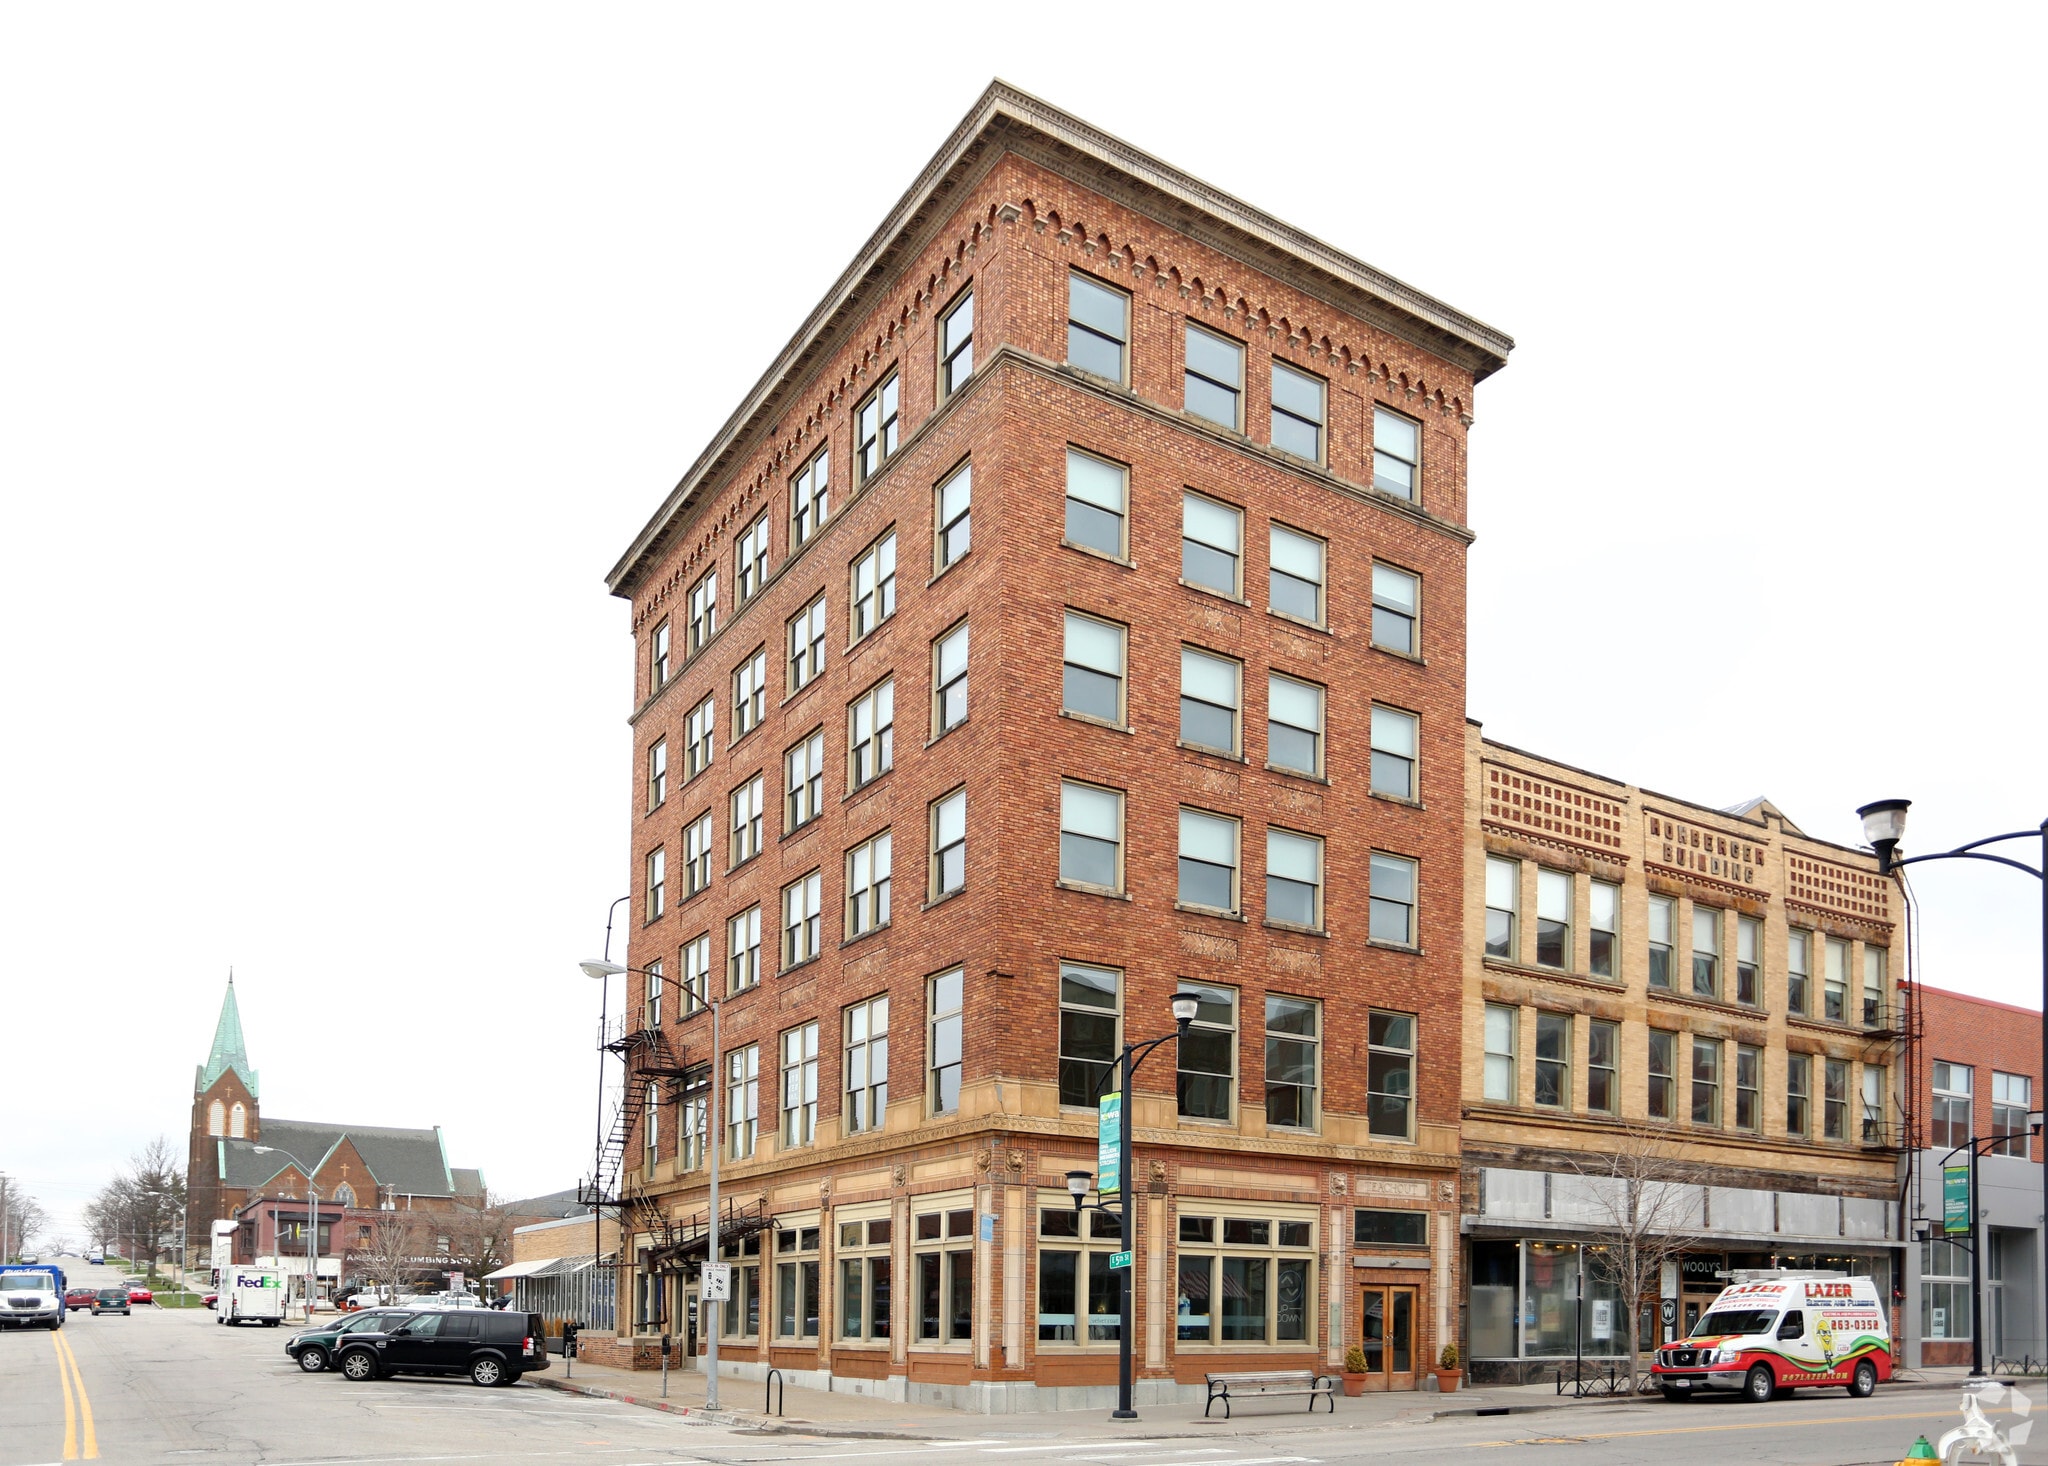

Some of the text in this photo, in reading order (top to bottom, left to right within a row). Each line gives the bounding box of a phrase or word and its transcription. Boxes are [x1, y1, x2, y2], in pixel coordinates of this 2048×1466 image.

[1650, 817, 1764, 866] HOHBERGER
[1663, 843, 1753, 883] BUIDING
[1365, 1181, 1418, 1195] TEACHOUT
[346, 1254, 391, 1263] AMERICA
[401, 1256, 449, 1264] PLUMBING
[1682, 1261, 1721, 1273] WOOLY'S
[237, 1275, 282, 1288] FedEx
[1724, 1285, 1788, 1296] LAZER
[1804, 1283, 1853, 1298] LAZER
[1663, 1306, 1673, 1318] W
[1830, 1320, 1879, 1330] 263-0352
[1781, 1372, 1849, 1382] 247LAZER.COM
